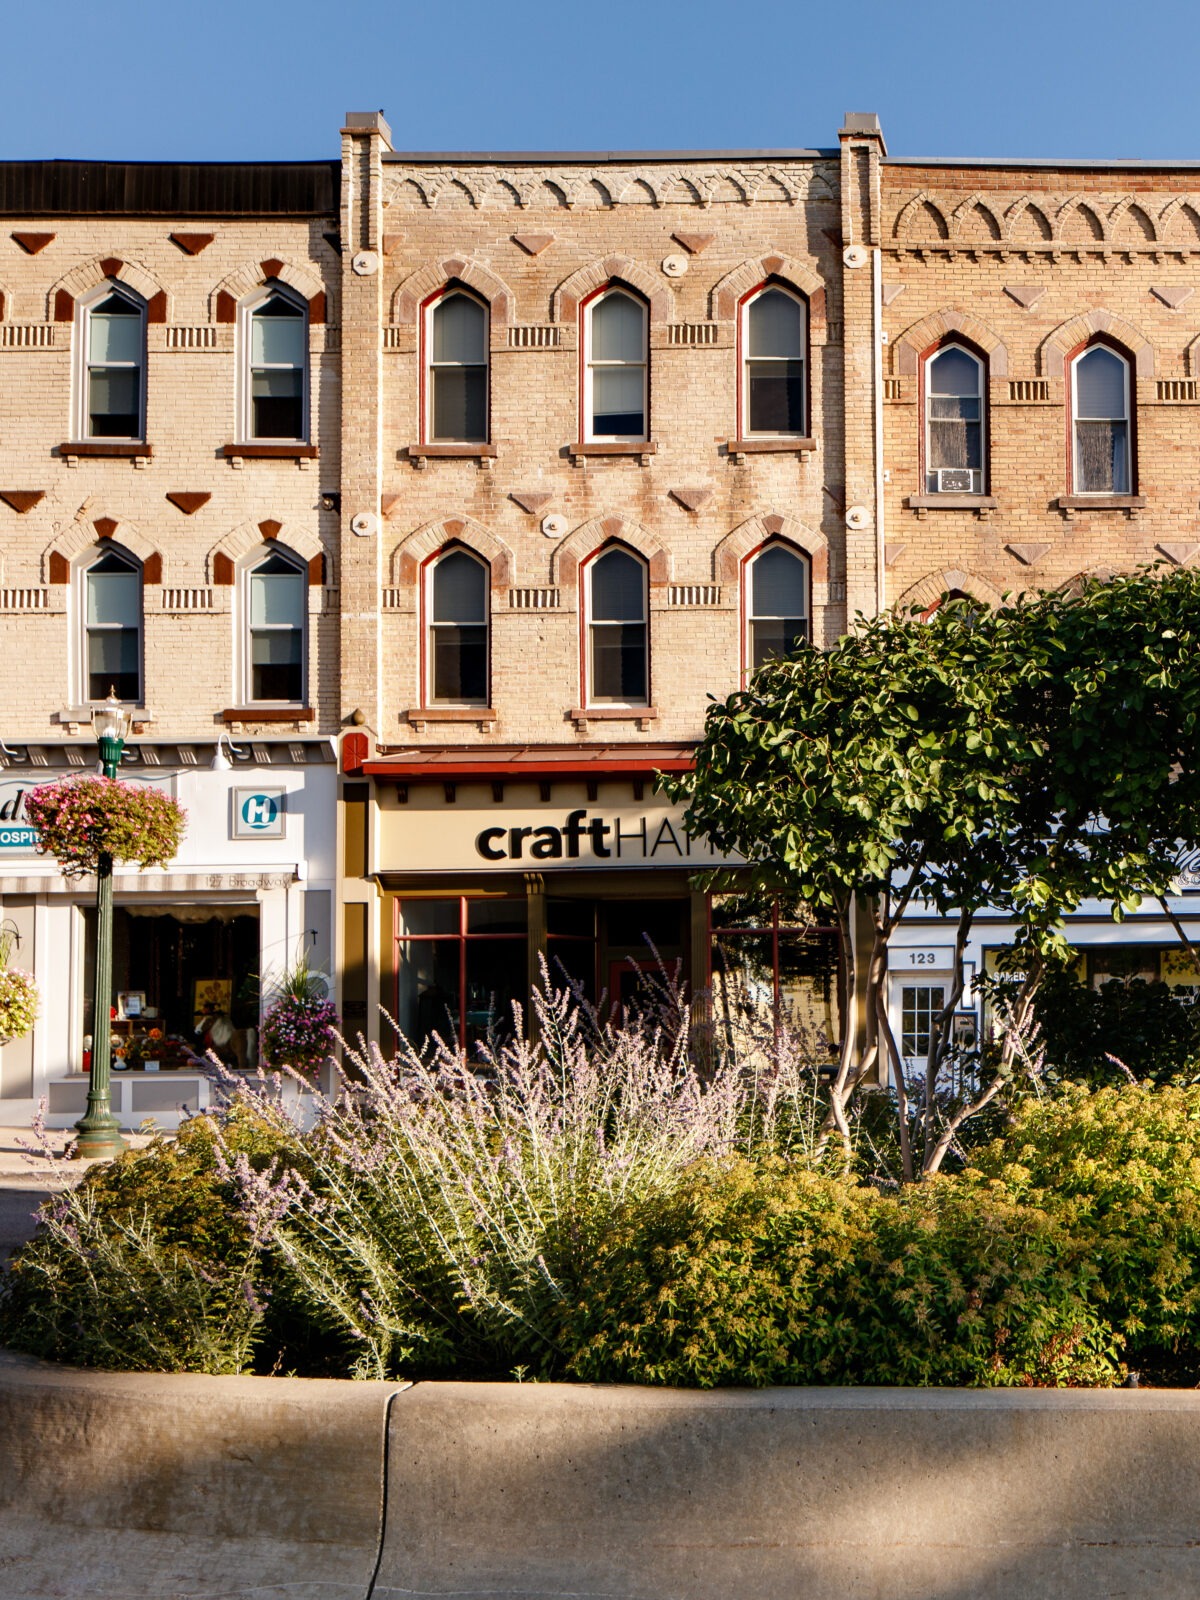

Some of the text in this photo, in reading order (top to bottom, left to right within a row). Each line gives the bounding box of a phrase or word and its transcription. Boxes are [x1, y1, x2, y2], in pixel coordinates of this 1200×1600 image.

[0, 832, 39, 843] OSPI
[475, 809, 716, 861] craftHA
[205, 875, 292, 889] 127 Broadway
[909, 953, 936, 964] 123
